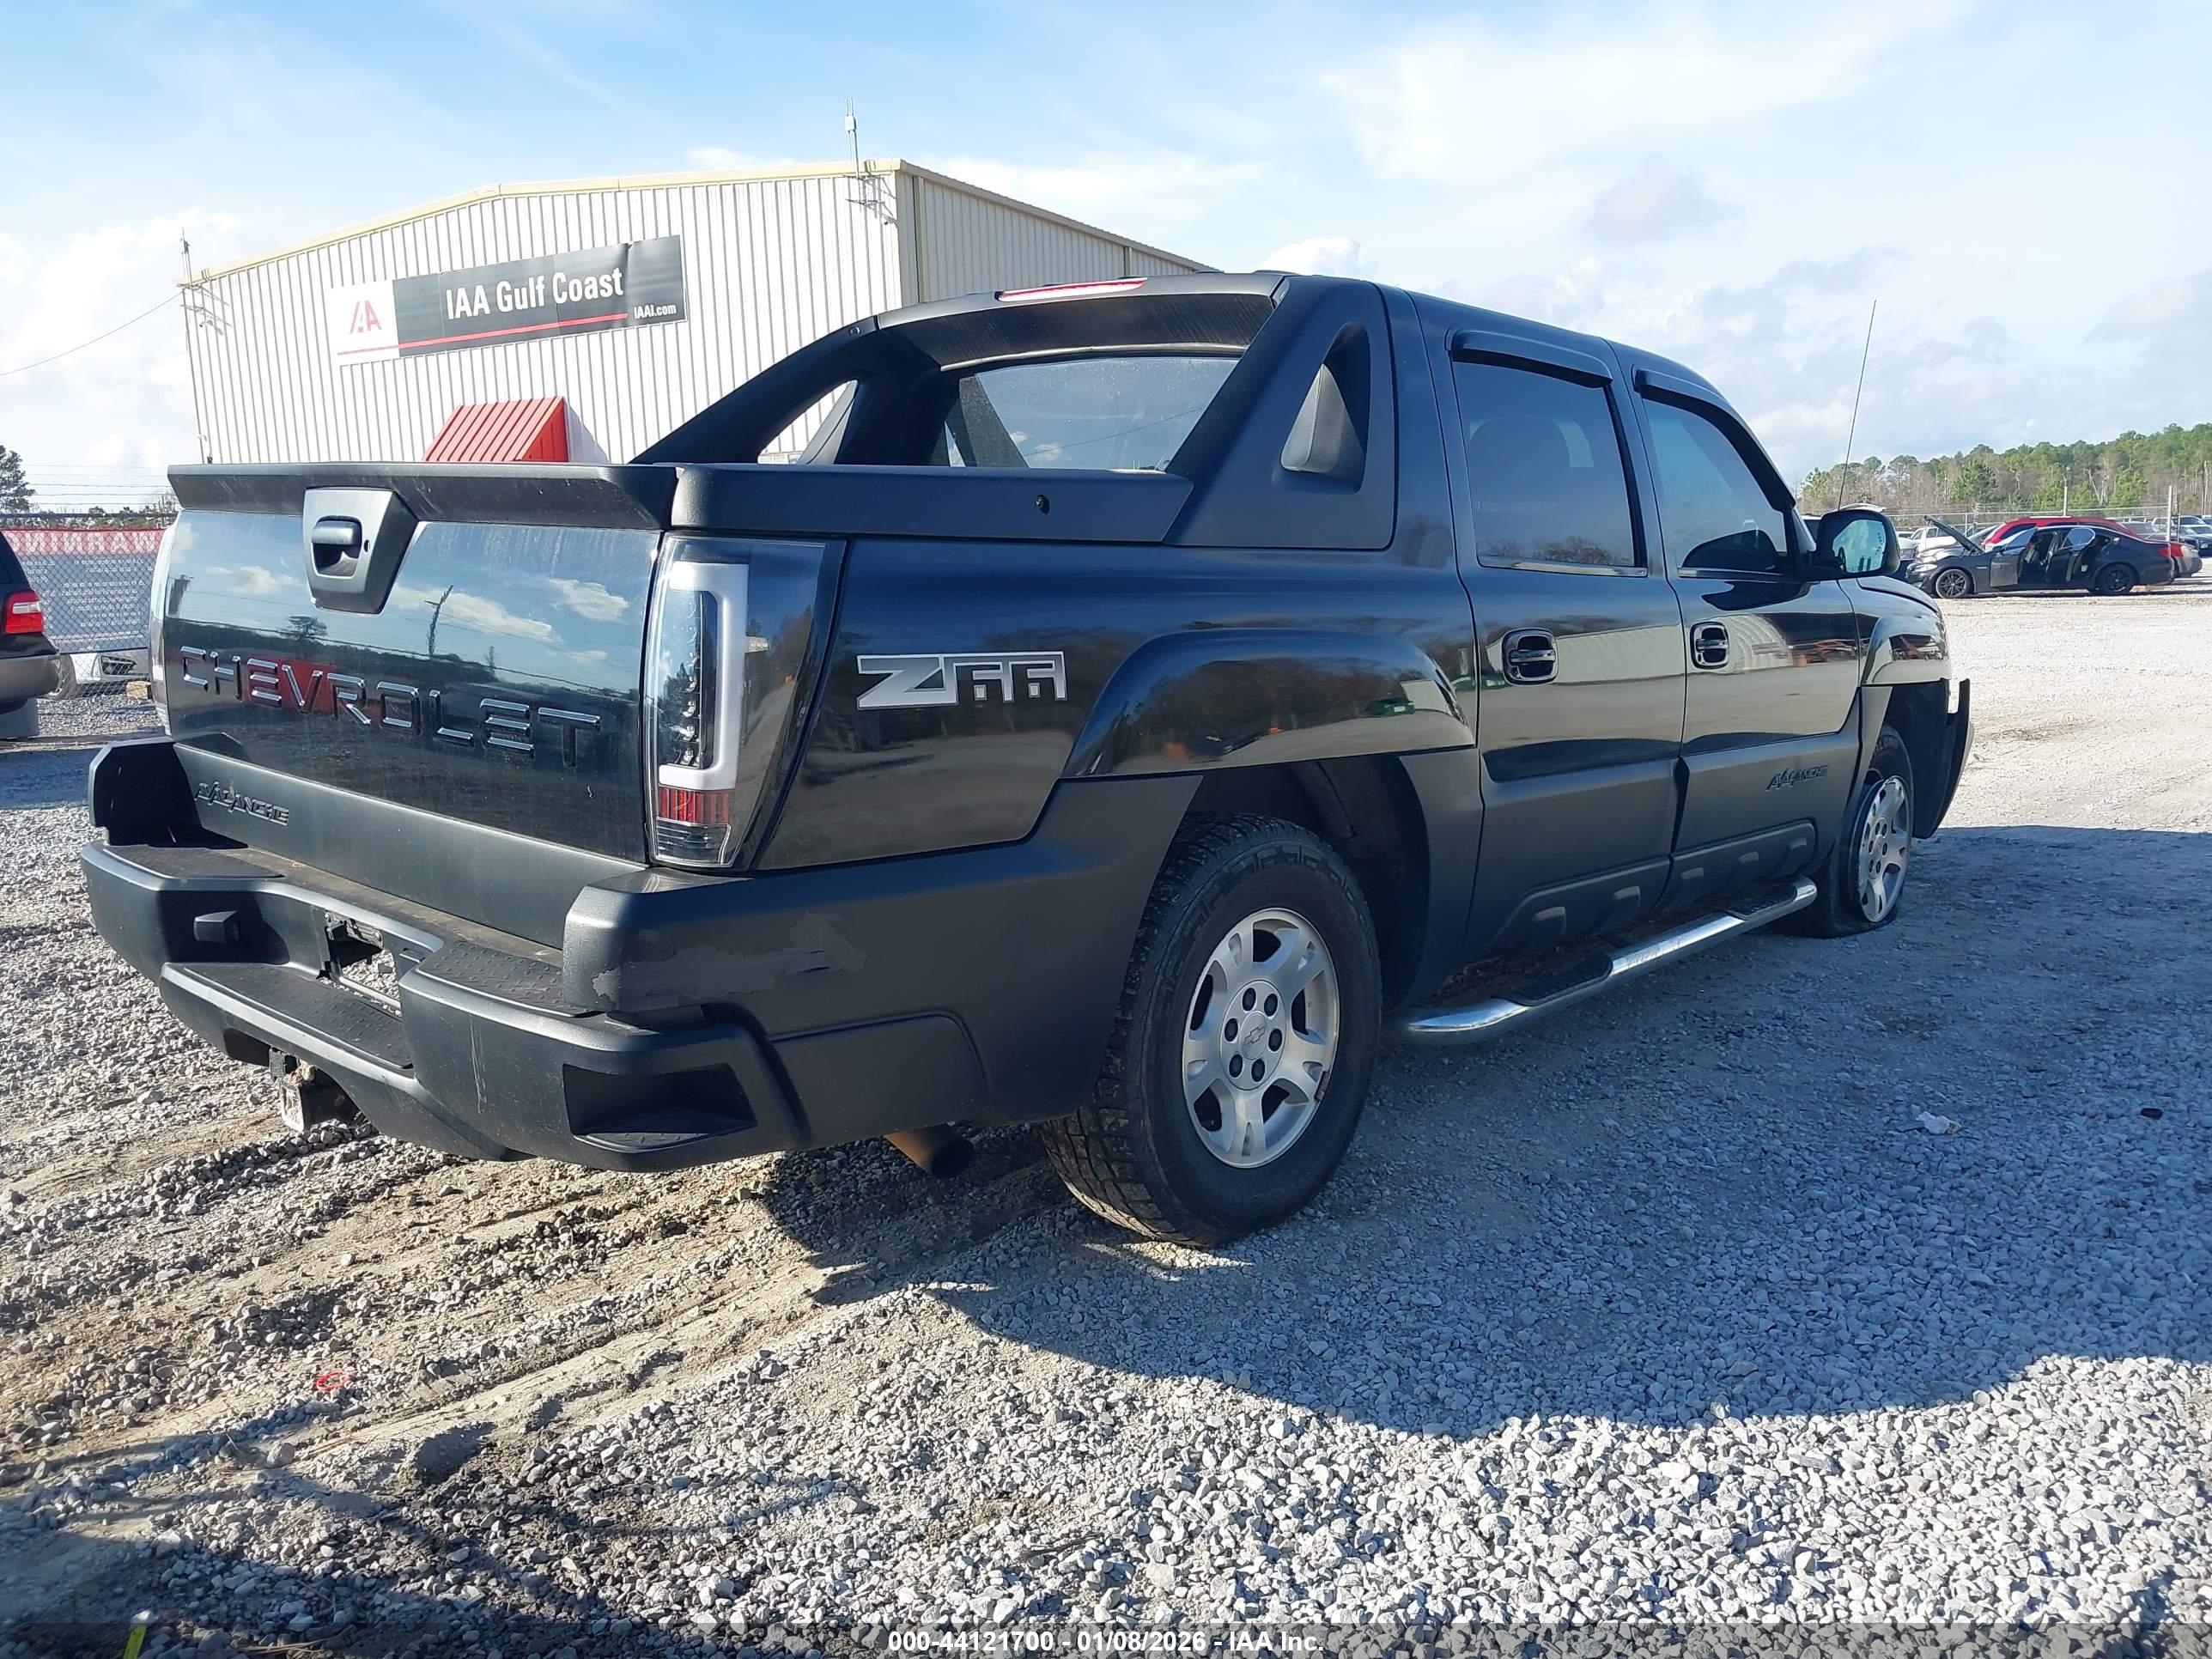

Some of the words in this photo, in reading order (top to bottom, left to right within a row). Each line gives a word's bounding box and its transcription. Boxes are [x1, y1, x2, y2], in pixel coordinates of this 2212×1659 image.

[446, 284, 491, 319] IAA
[495, 275, 545, 313] Gulf
[552, 267, 624, 305] Coast
[634, 304, 677, 319] IAAI.com
[179, 645, 601, 768] CHEVROLET
[193, 780, 290, 826] AVALANCHE
